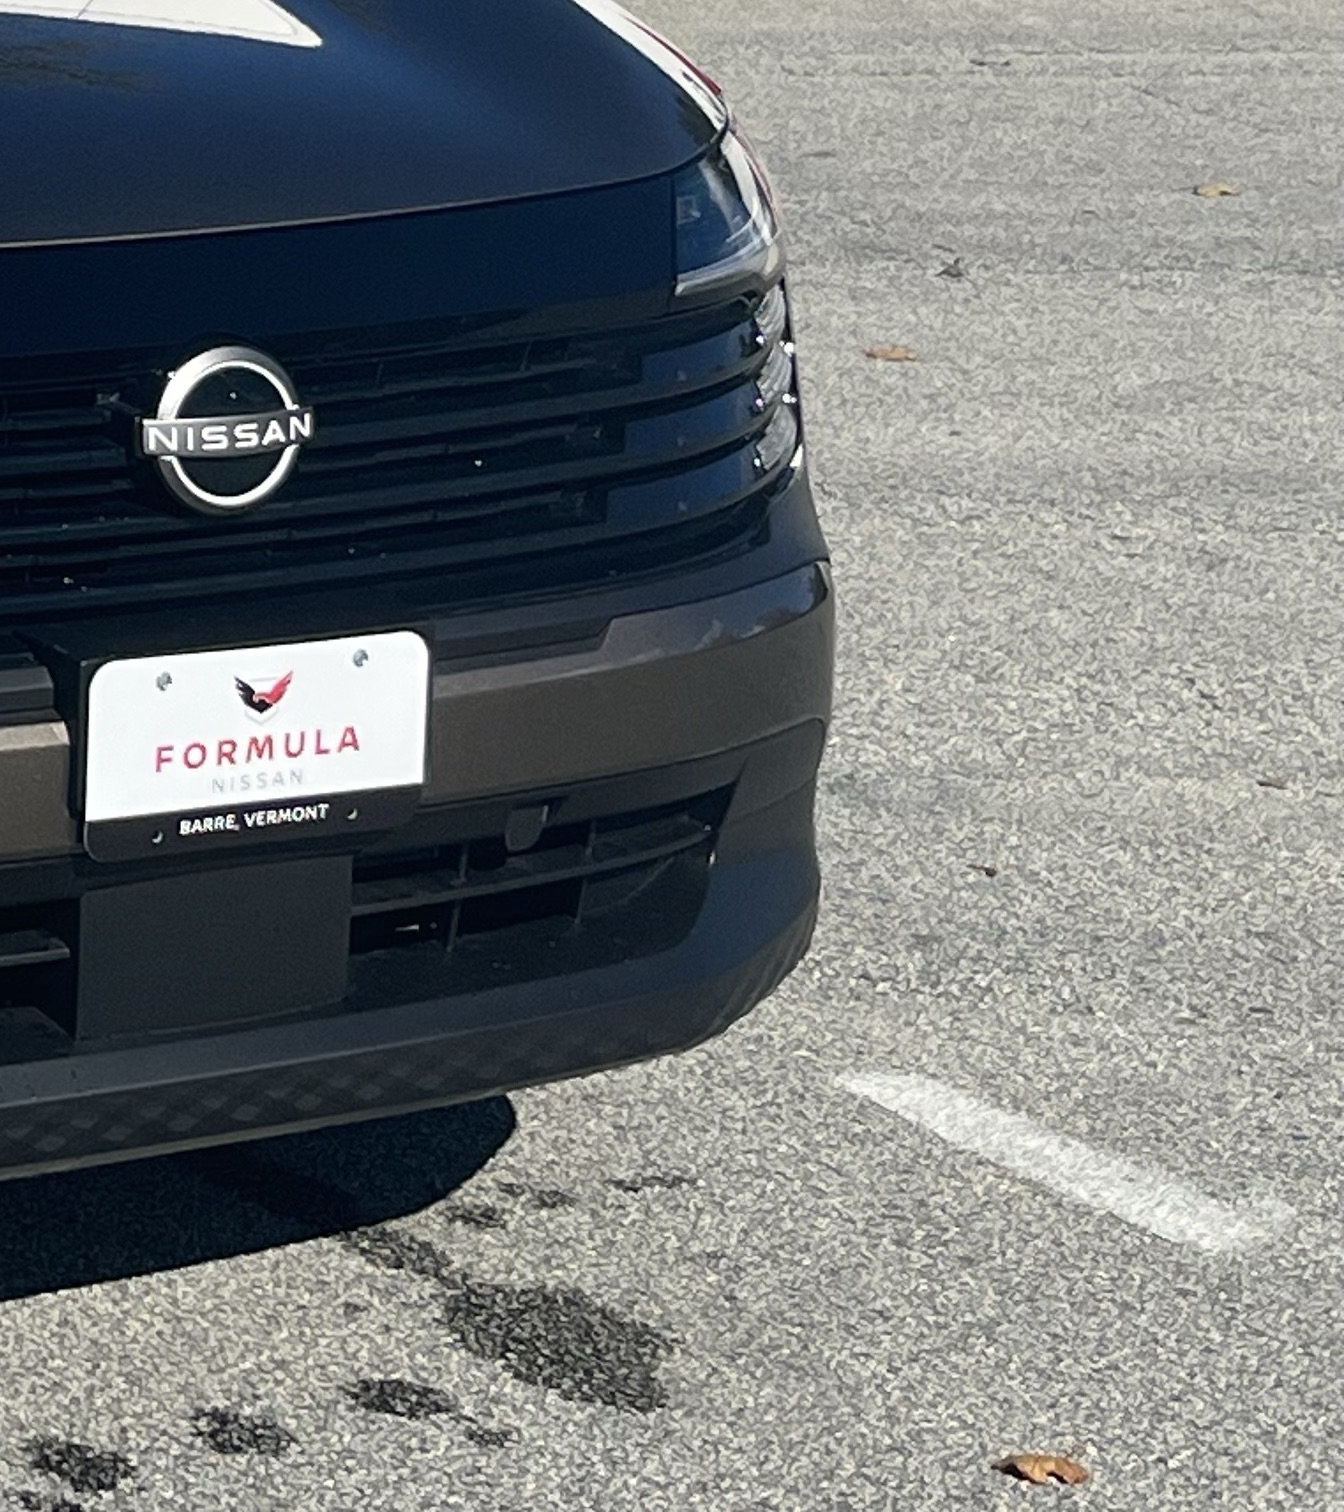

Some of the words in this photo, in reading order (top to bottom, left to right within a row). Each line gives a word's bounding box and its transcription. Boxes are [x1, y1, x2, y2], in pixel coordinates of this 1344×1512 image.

[147, 412, 311, 452] NISSAN
[155, 726, 361, 772] FORMULA
[211, 769, 305, 794] NISSAN
[179, 814, 240, 836] BARRE,
[244, 803, 330, 829] VERMONT
